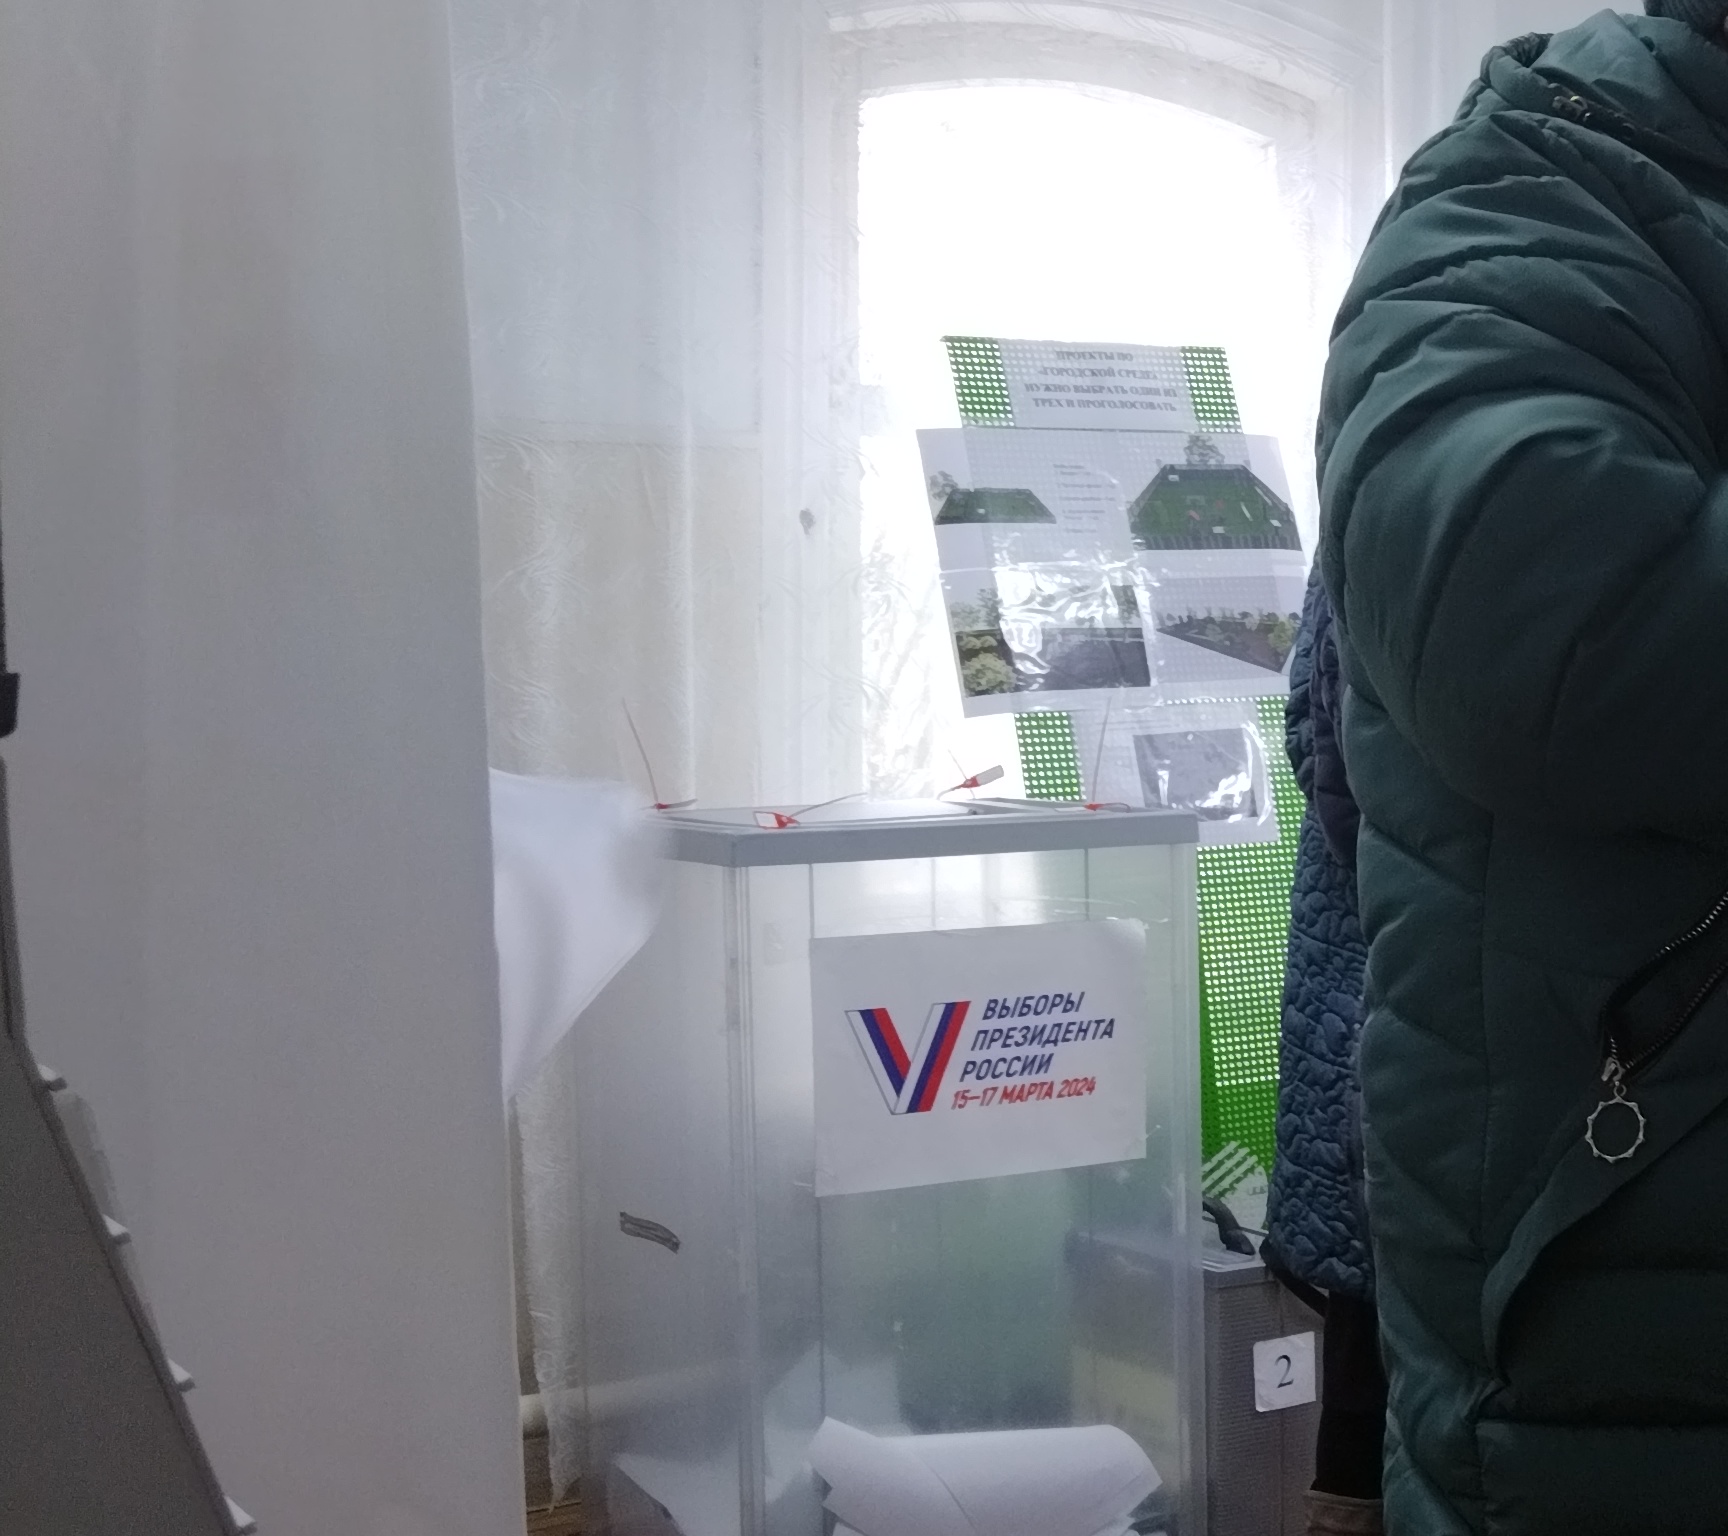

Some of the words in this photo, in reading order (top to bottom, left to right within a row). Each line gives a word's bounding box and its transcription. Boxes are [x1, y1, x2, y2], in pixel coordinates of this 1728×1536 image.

[1055, 350, 1115, 361] ПРОЕКТЫ
[1117, 352, 1134, 362] ПО
[1073, 384, 1128, 395] ВЫБРАТЬ
[1077, 399, 1177, 412] ПРОГОЛОСОВАТЬ
[982, 991, 1086, 1021] ВЫБОРЫ
[970, 1018, 1116, 1051] ПРЕЗИДЕНТА
[959, 1053, 1055, 1083] РОССИИ
[998, 1079, 1054, 1105] МАРТА
[1056, 1076, 1097, 1099] 2024
[1274, 1354, 1295, 1389] 2
